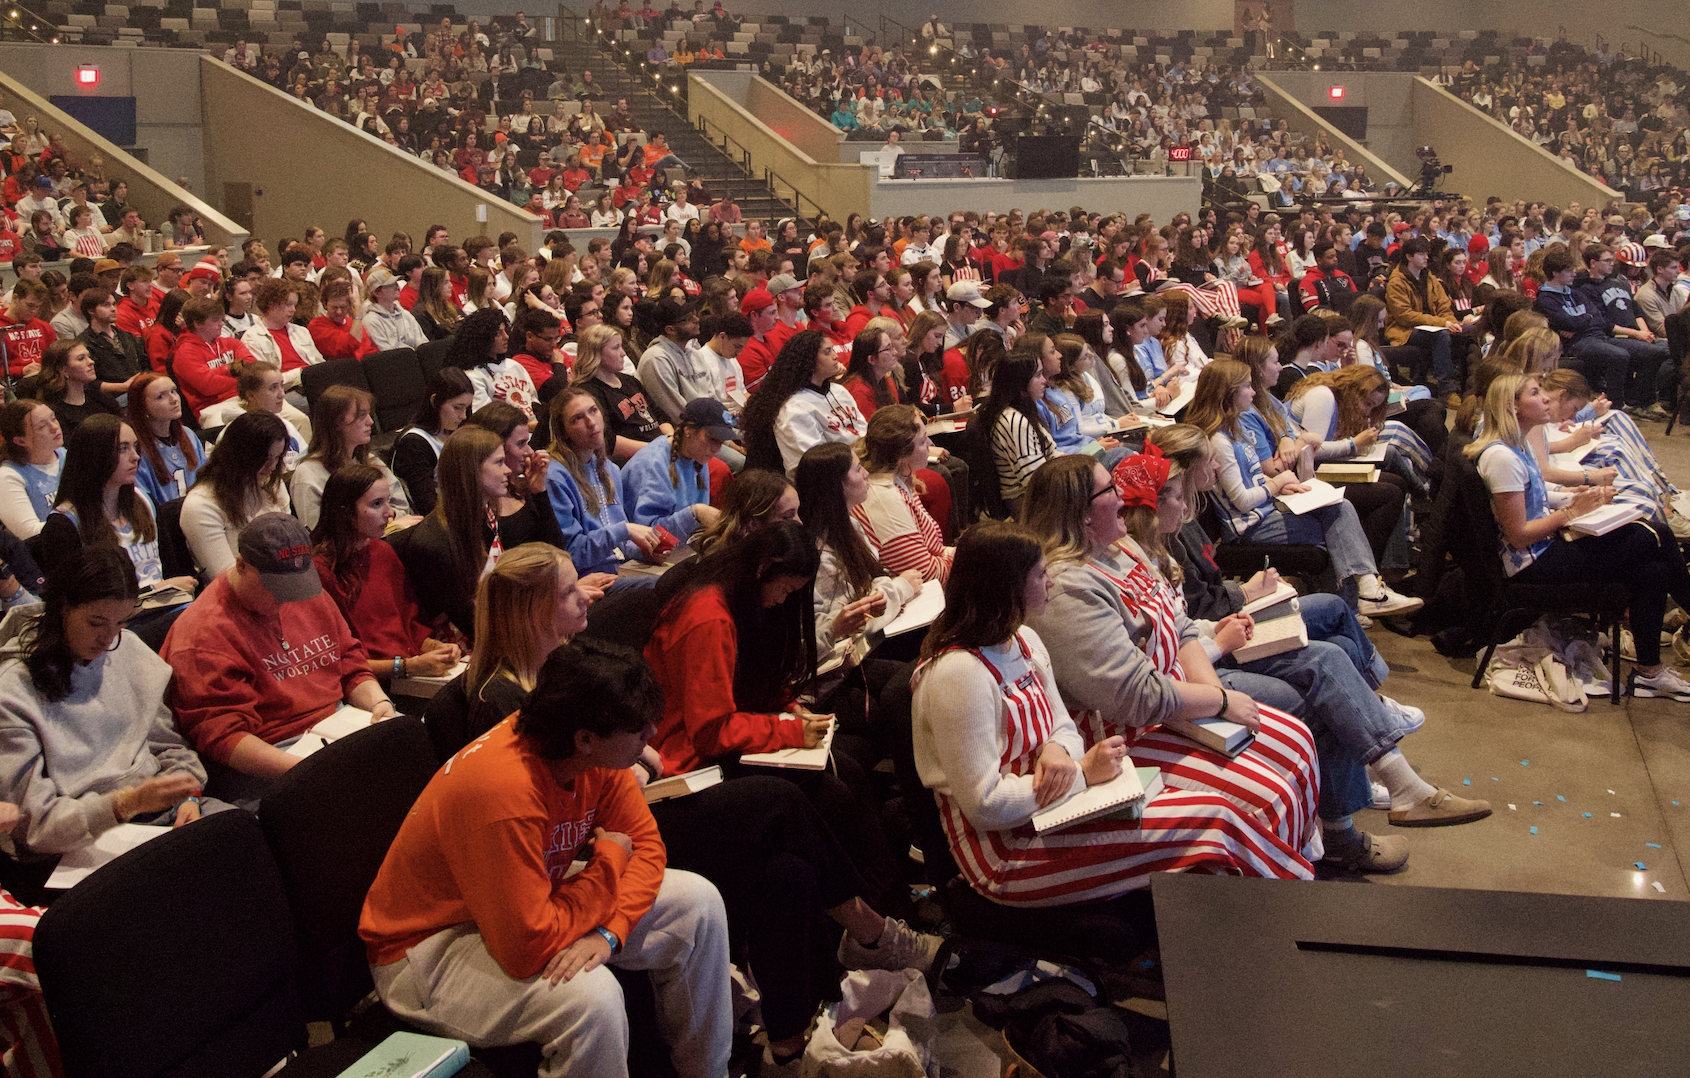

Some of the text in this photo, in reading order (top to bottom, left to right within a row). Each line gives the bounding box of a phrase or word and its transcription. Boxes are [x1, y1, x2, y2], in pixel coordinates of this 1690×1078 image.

[173, 468, 187, 498] 1
[129, 540, 159, 563] RTH
[278, 547, 291, 560] NC
[273, 650, 341, 682] WOLPACK
